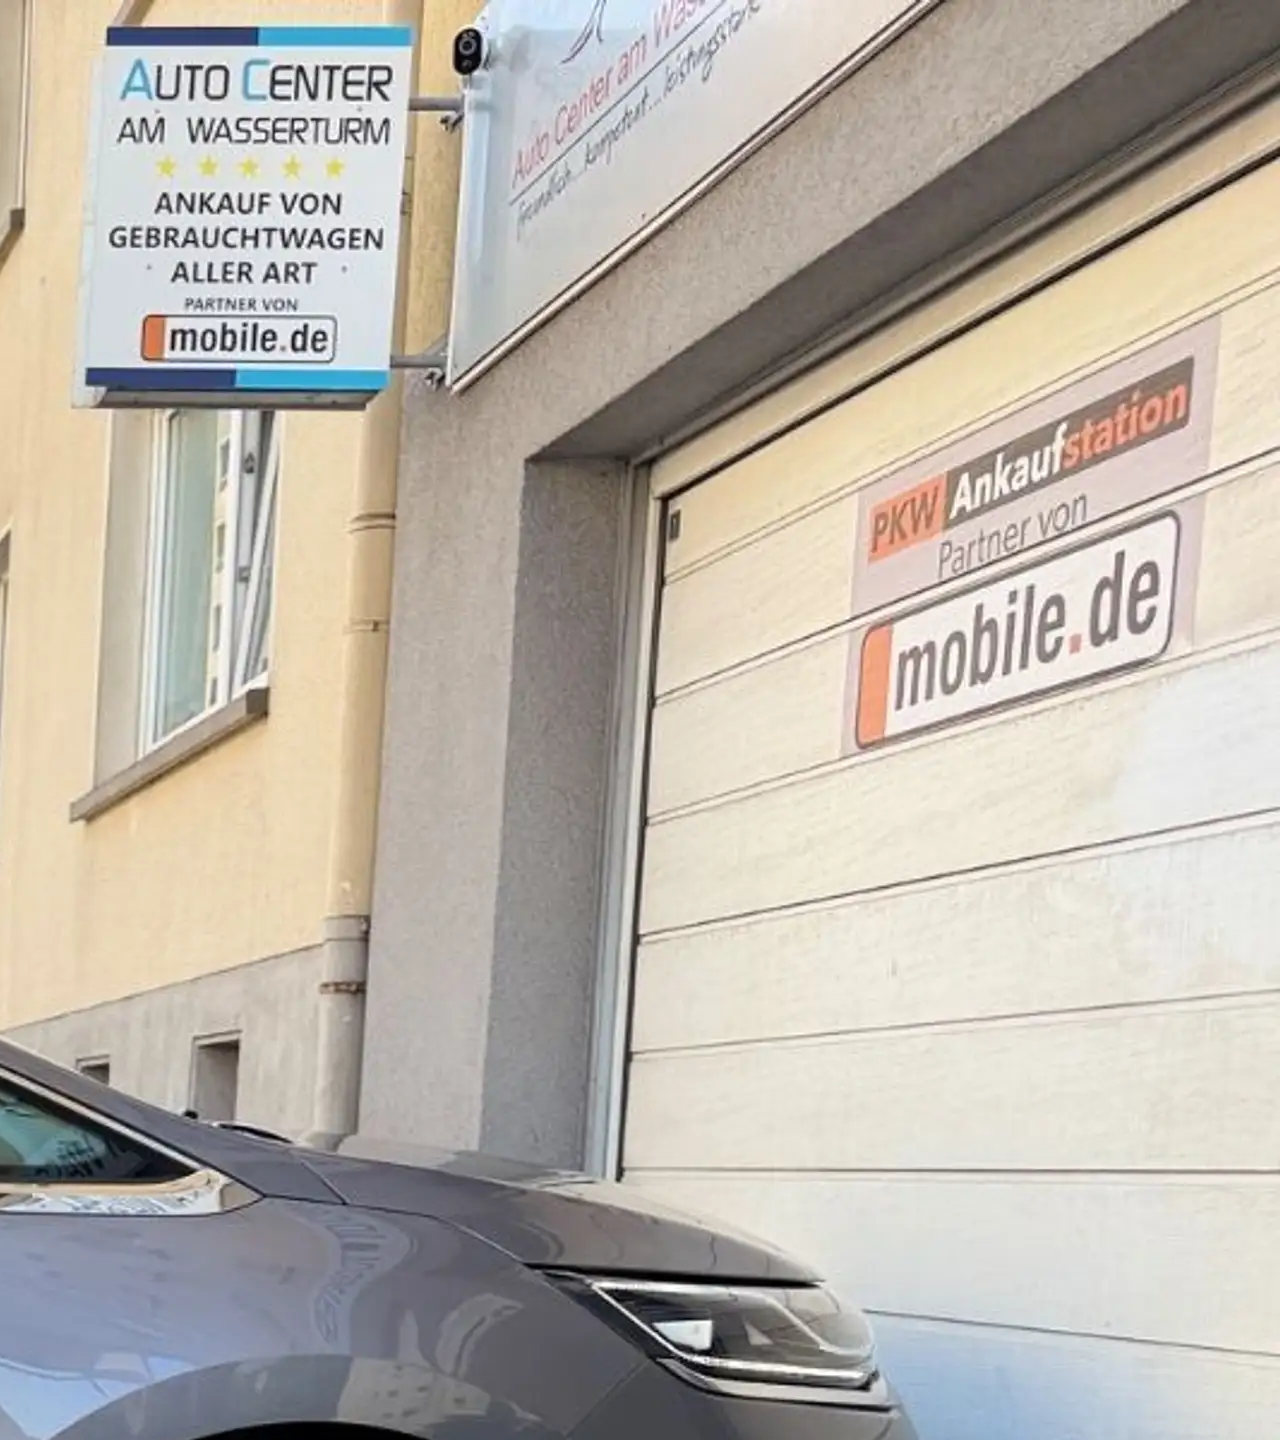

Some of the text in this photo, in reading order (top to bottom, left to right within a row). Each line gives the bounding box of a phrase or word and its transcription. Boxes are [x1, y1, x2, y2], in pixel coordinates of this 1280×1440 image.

[512, 130, 550, 190] Auto
[554, 64, 614, 145] Center
[617, 34, 648, 86] am
[116, 116, 391, 145] AM WASSERTURM
[153, 191, 343, 216] ANKAUF VON
[108, 225, 384, 251] GEBRAUCHTWAGEN
[170, 261, 318, 285] ALLER ART
[184, 297, 298, 312] PARTNER VON
[169, 321, 329, 354] mobile.de
[870, 382, 1188, 554] PKW Ankaufstation
[938, 492, 1088, 579] Partner von
[894, 549, 1162, 711] mobile.de
